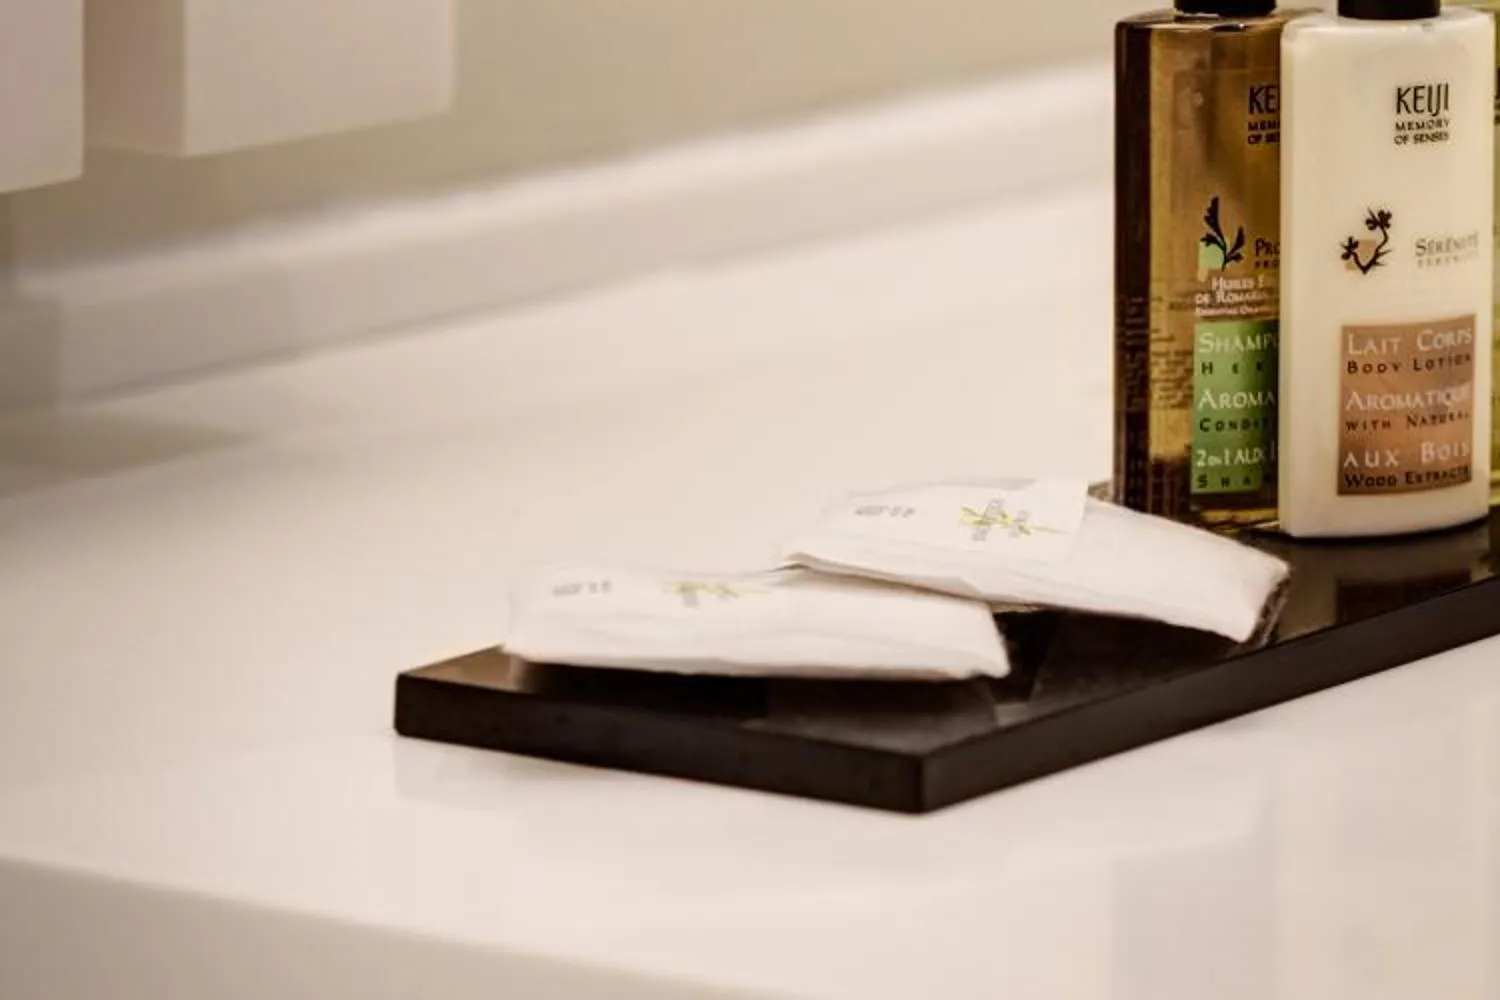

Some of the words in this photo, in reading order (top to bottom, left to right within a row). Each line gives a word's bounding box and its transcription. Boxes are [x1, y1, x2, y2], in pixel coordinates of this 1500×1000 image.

[1247, 85, 1280, 114] KE
[1397, 83, 1449, 116] KEIJI
[1395, 118, 1450, 131] MEMORY
[1394, 135, 1409, 145] OF
[1347, 332, 1402, 356] LAIT
[1416, 327, 1473, 352] CORPS
[1347, 360, 1401, 374] BODY
[1345, 418, 1391, 432] WITH
[1343, 449, 1400, 469] AUX
[1344, 473, 1397, 488] WOOD
